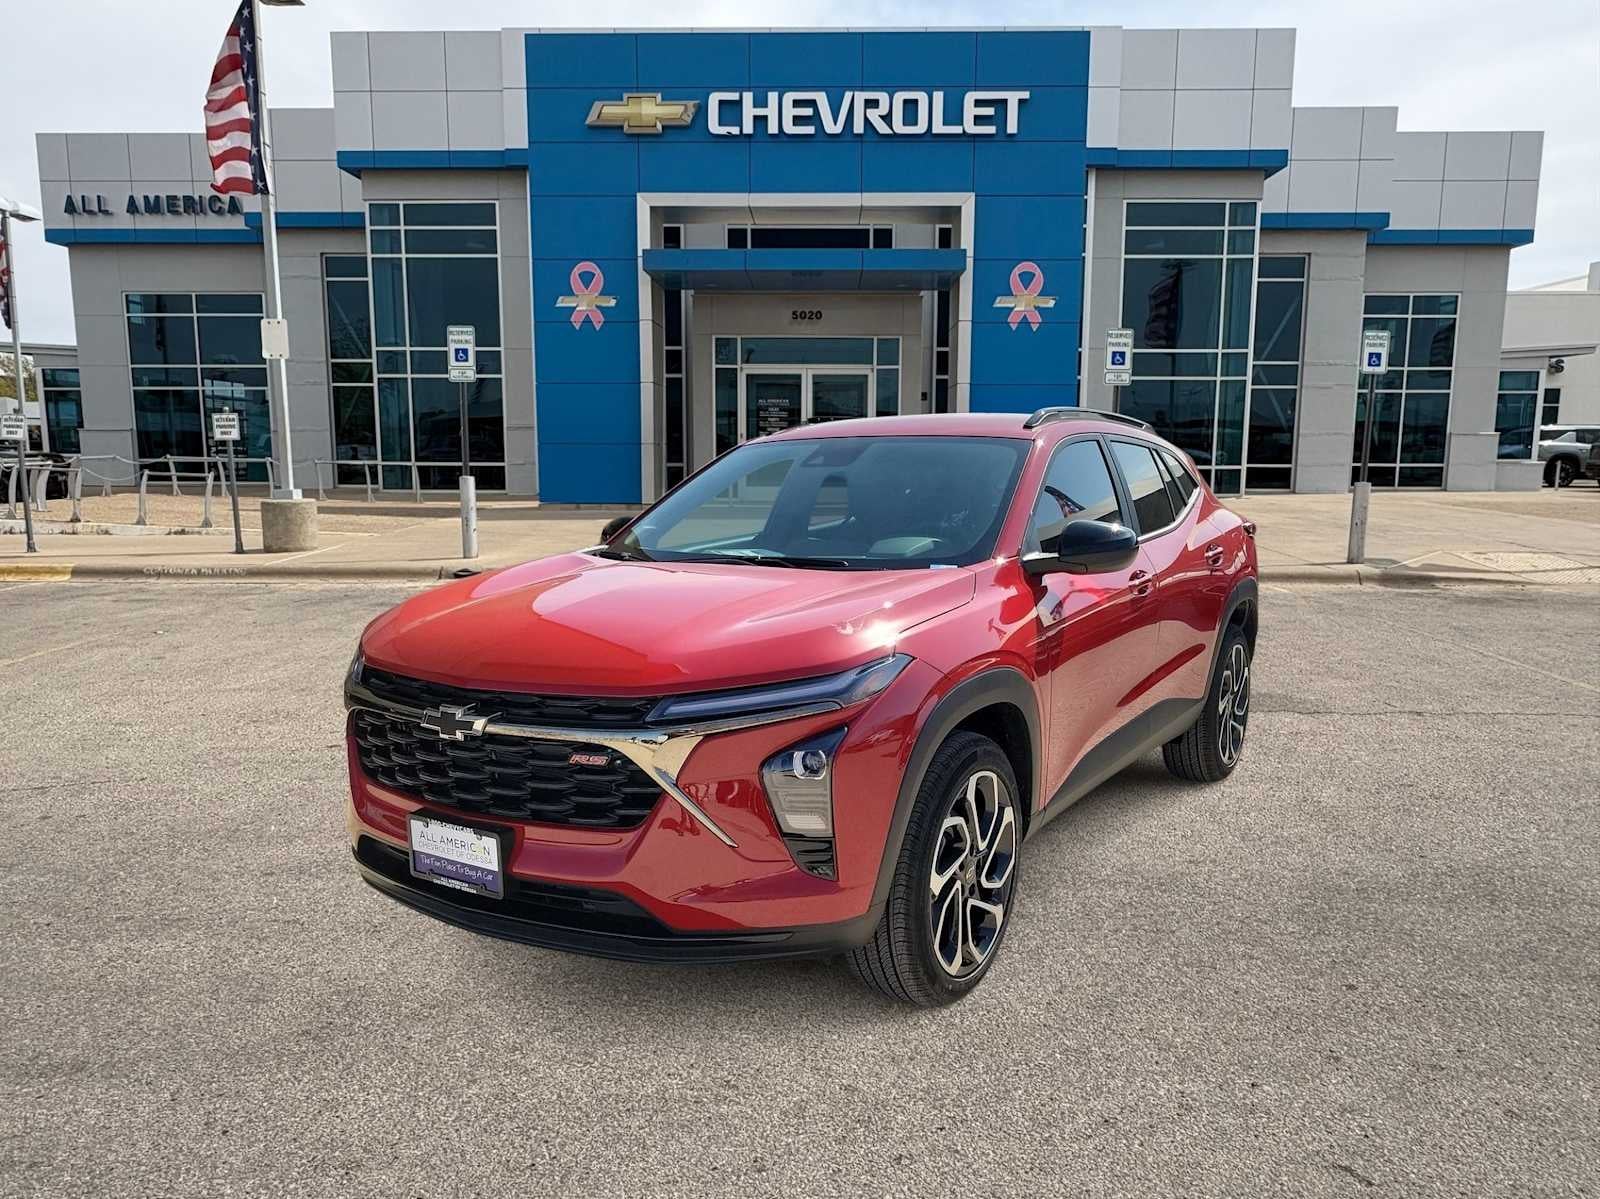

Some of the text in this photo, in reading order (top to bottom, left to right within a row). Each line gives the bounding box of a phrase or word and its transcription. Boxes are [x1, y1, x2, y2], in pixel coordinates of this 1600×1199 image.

[707, 91, 1030, 135] CHEVROLET
[64, 194, 112, 215] ALL
[791, 310, 823, 320] 5020
[569, 754, 609, 766] RS
[419, 829, 491, 857] ALL AMERICN
